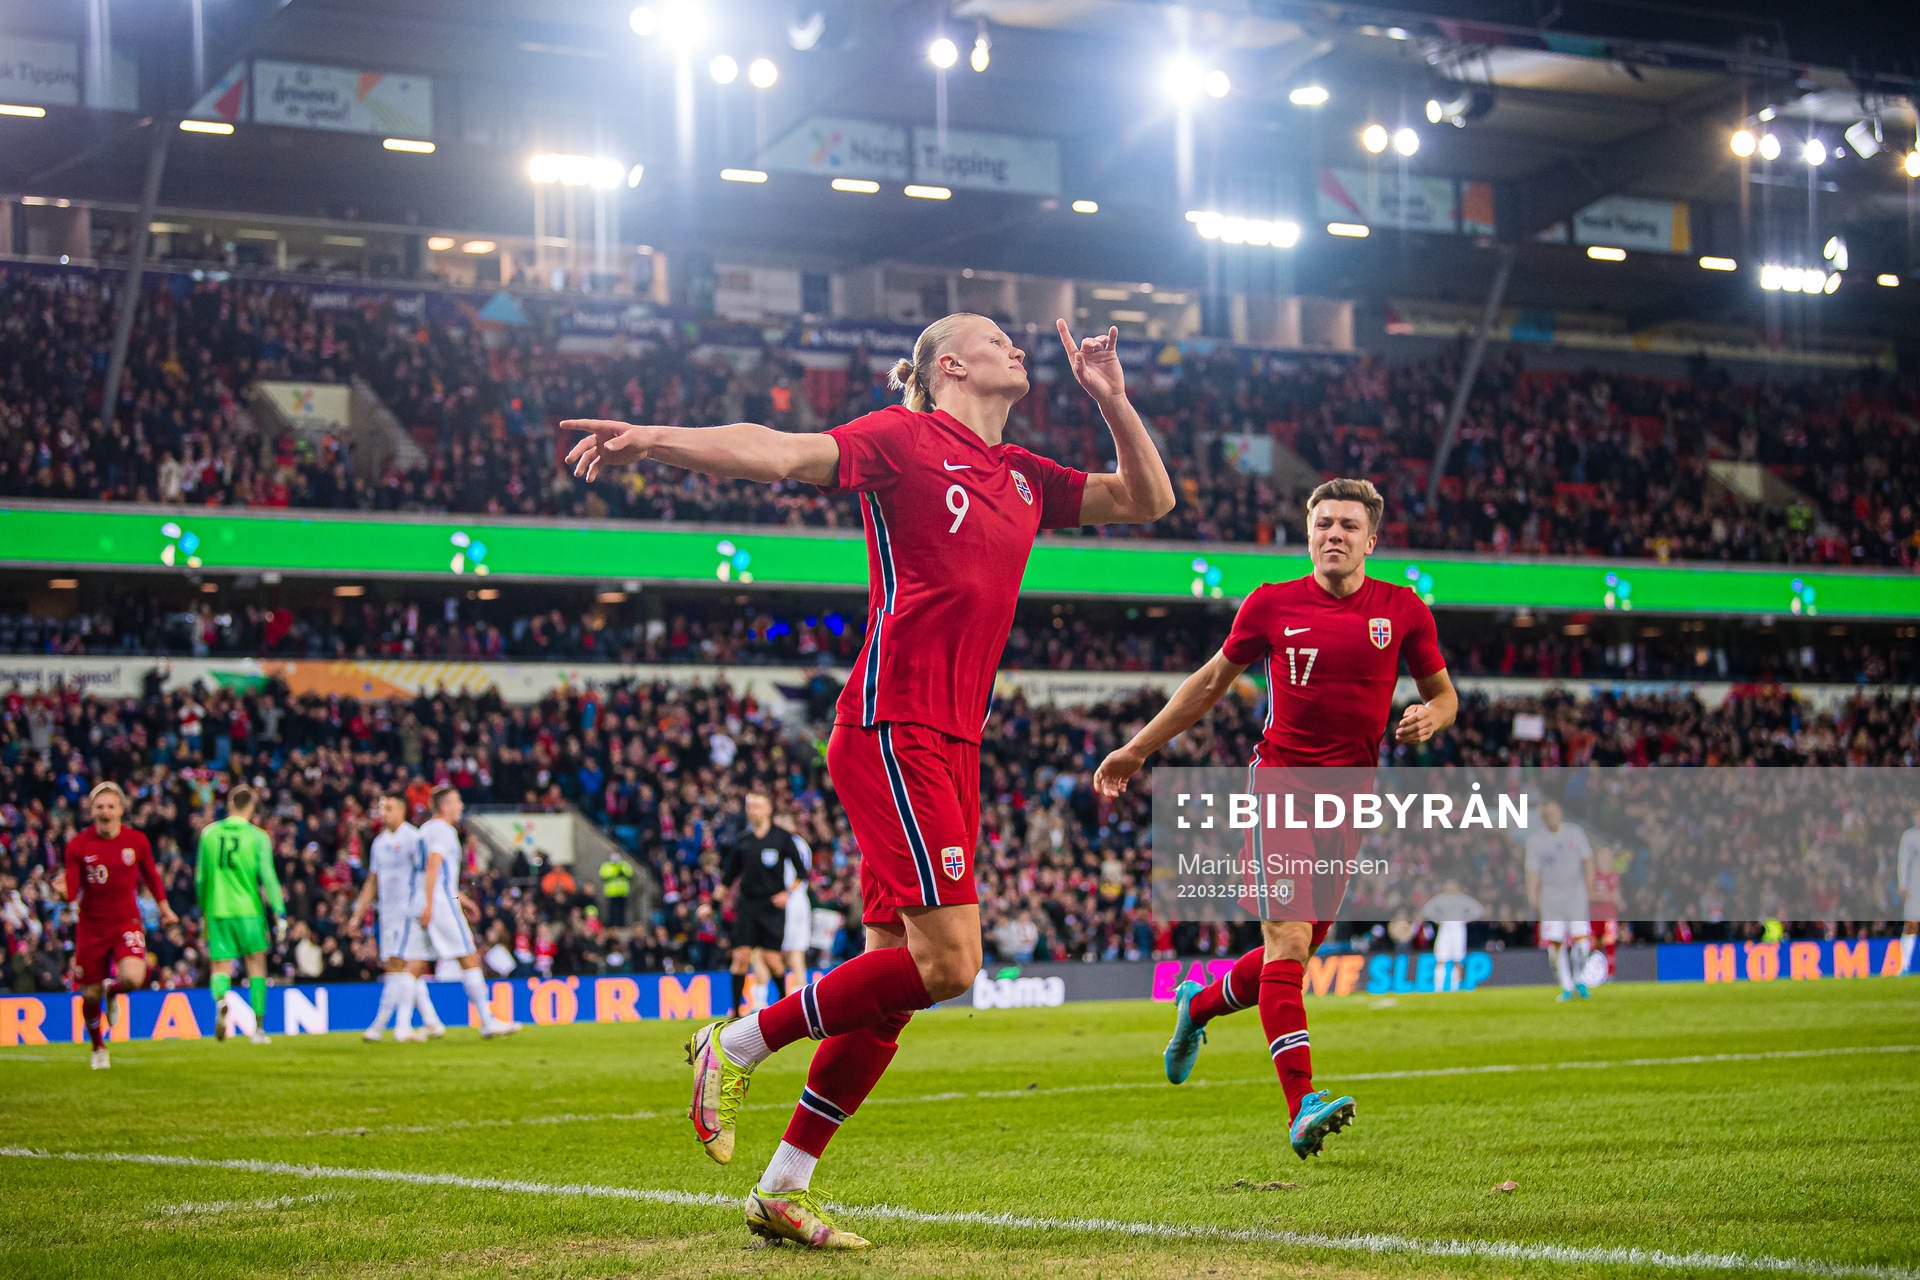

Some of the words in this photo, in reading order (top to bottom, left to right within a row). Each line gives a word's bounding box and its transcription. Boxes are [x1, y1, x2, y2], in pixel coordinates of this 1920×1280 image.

[946, 484, 970, 533] 9
[1285, 647, 1319, 686] 17
[219, 836, 239, 871] 12
[973, 968, 1065, 1010] bama
